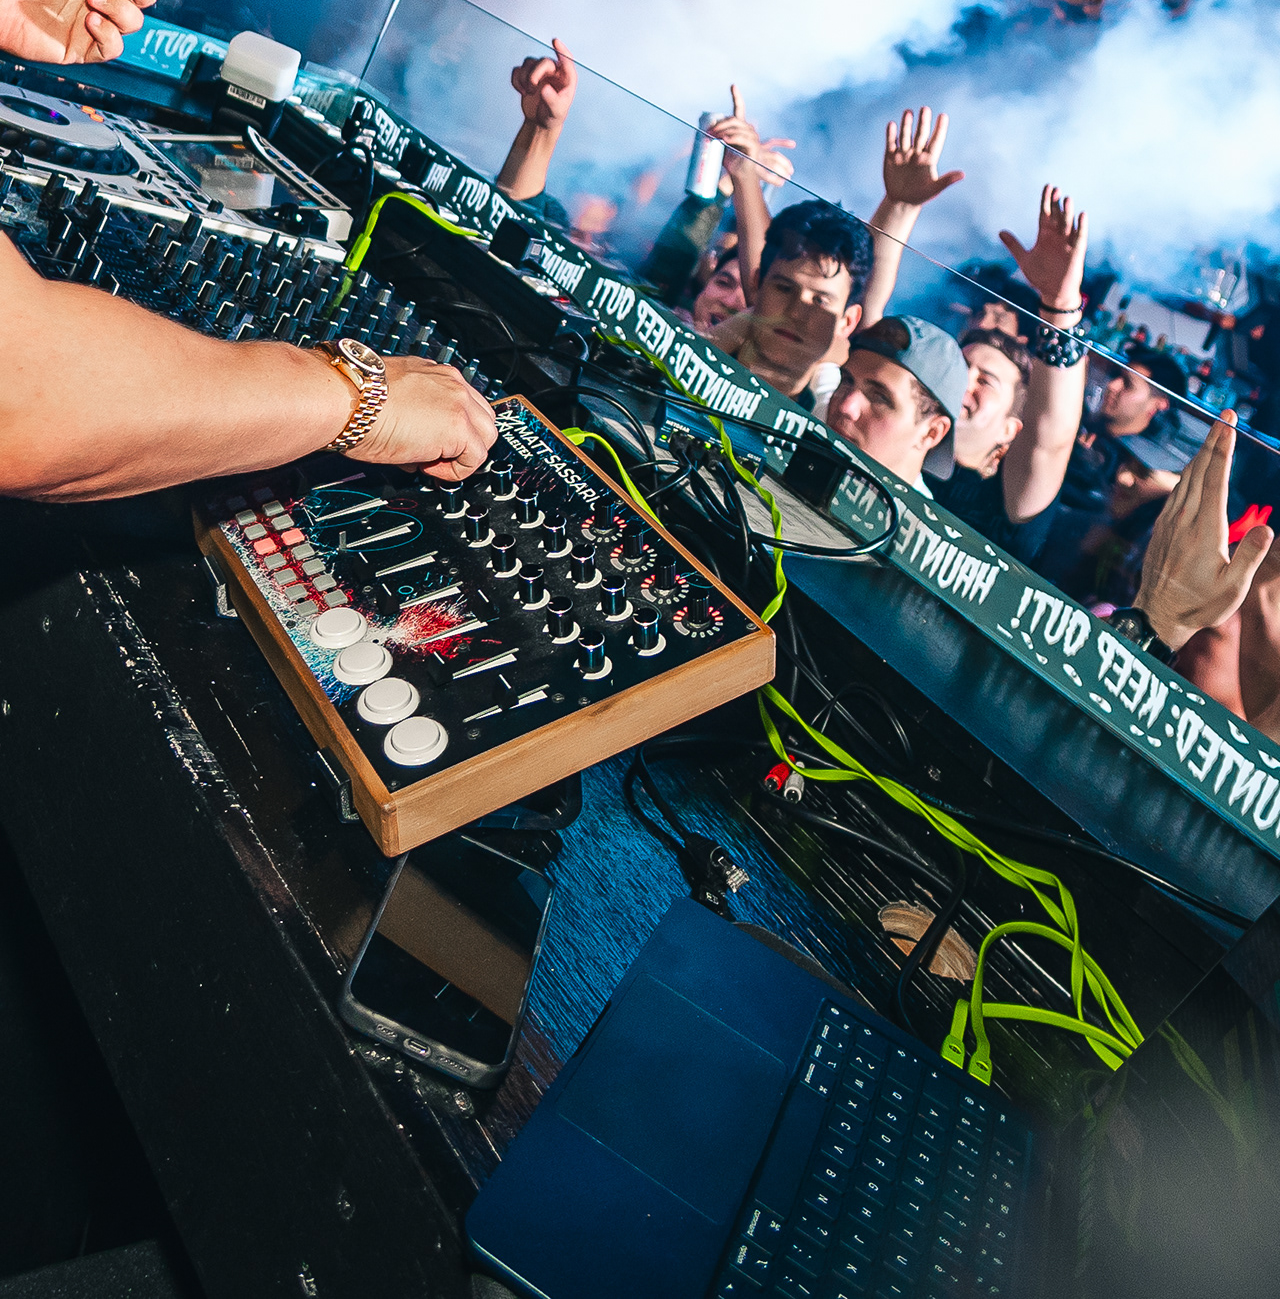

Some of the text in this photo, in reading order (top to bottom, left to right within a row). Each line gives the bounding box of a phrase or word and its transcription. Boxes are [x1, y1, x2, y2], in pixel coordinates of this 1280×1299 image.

[666, 419, 690, 434] NETGEAR
[502, 431, 534, 459] YAELTEX
[514, 425, 601, 503] MATT SASSARI
